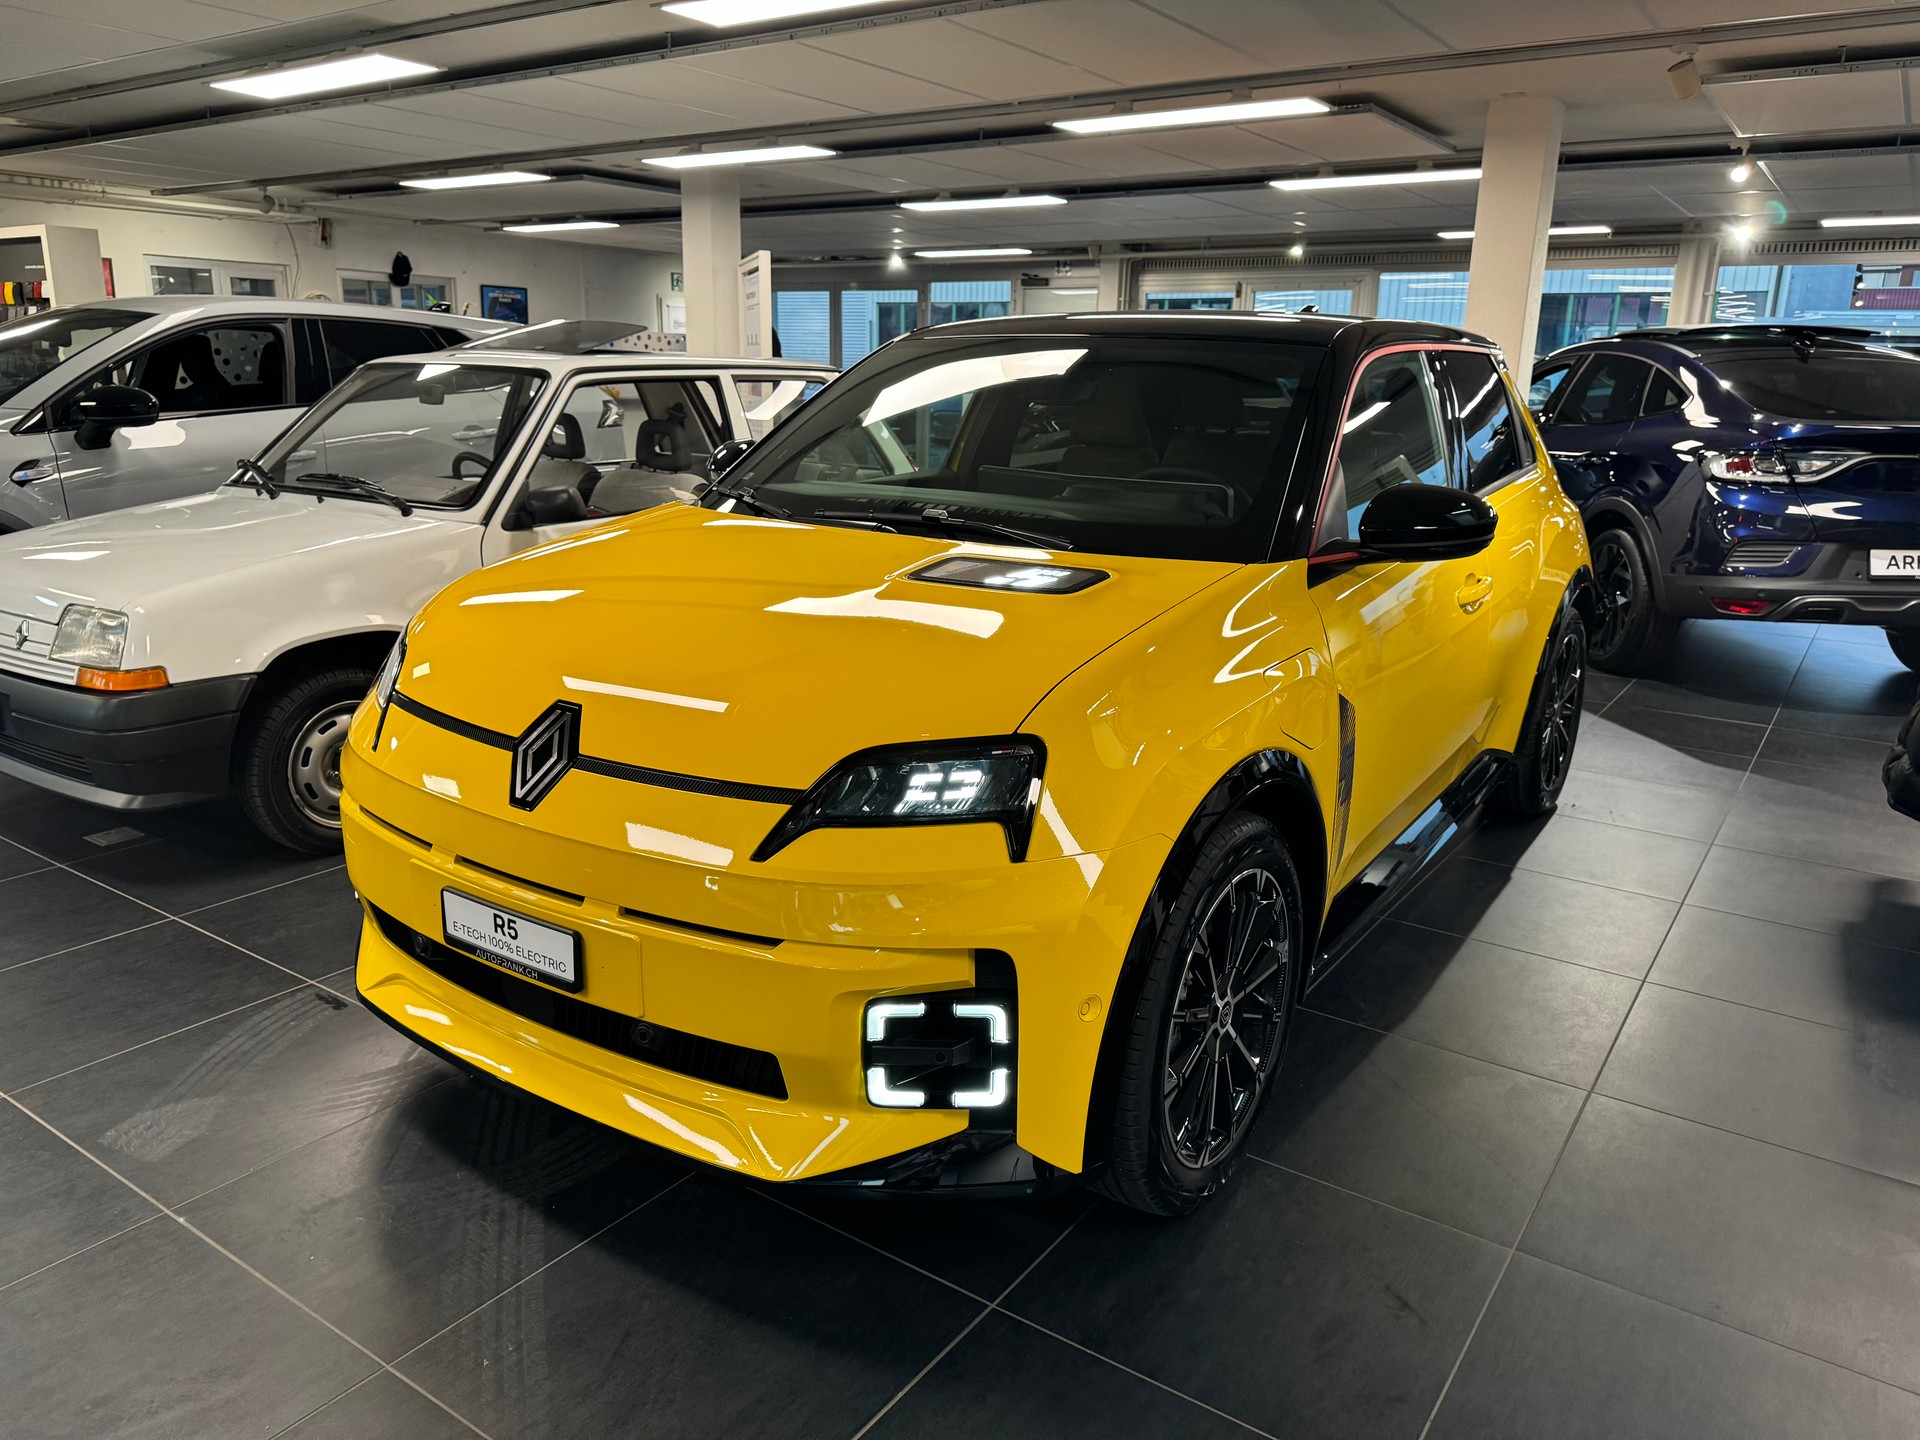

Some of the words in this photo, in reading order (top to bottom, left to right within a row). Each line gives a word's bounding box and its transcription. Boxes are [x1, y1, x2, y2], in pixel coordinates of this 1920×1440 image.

[1886, 555, 1920, 570] AR
[493, 912, 519, 940] R5
[453, 920, 486, 943] E-TECH
[488, 934, 514, 955] 100%
[516, 946, 567, 973] ELECTRIC
[475, 949, 538, 980] AUTOFRANK.CH
